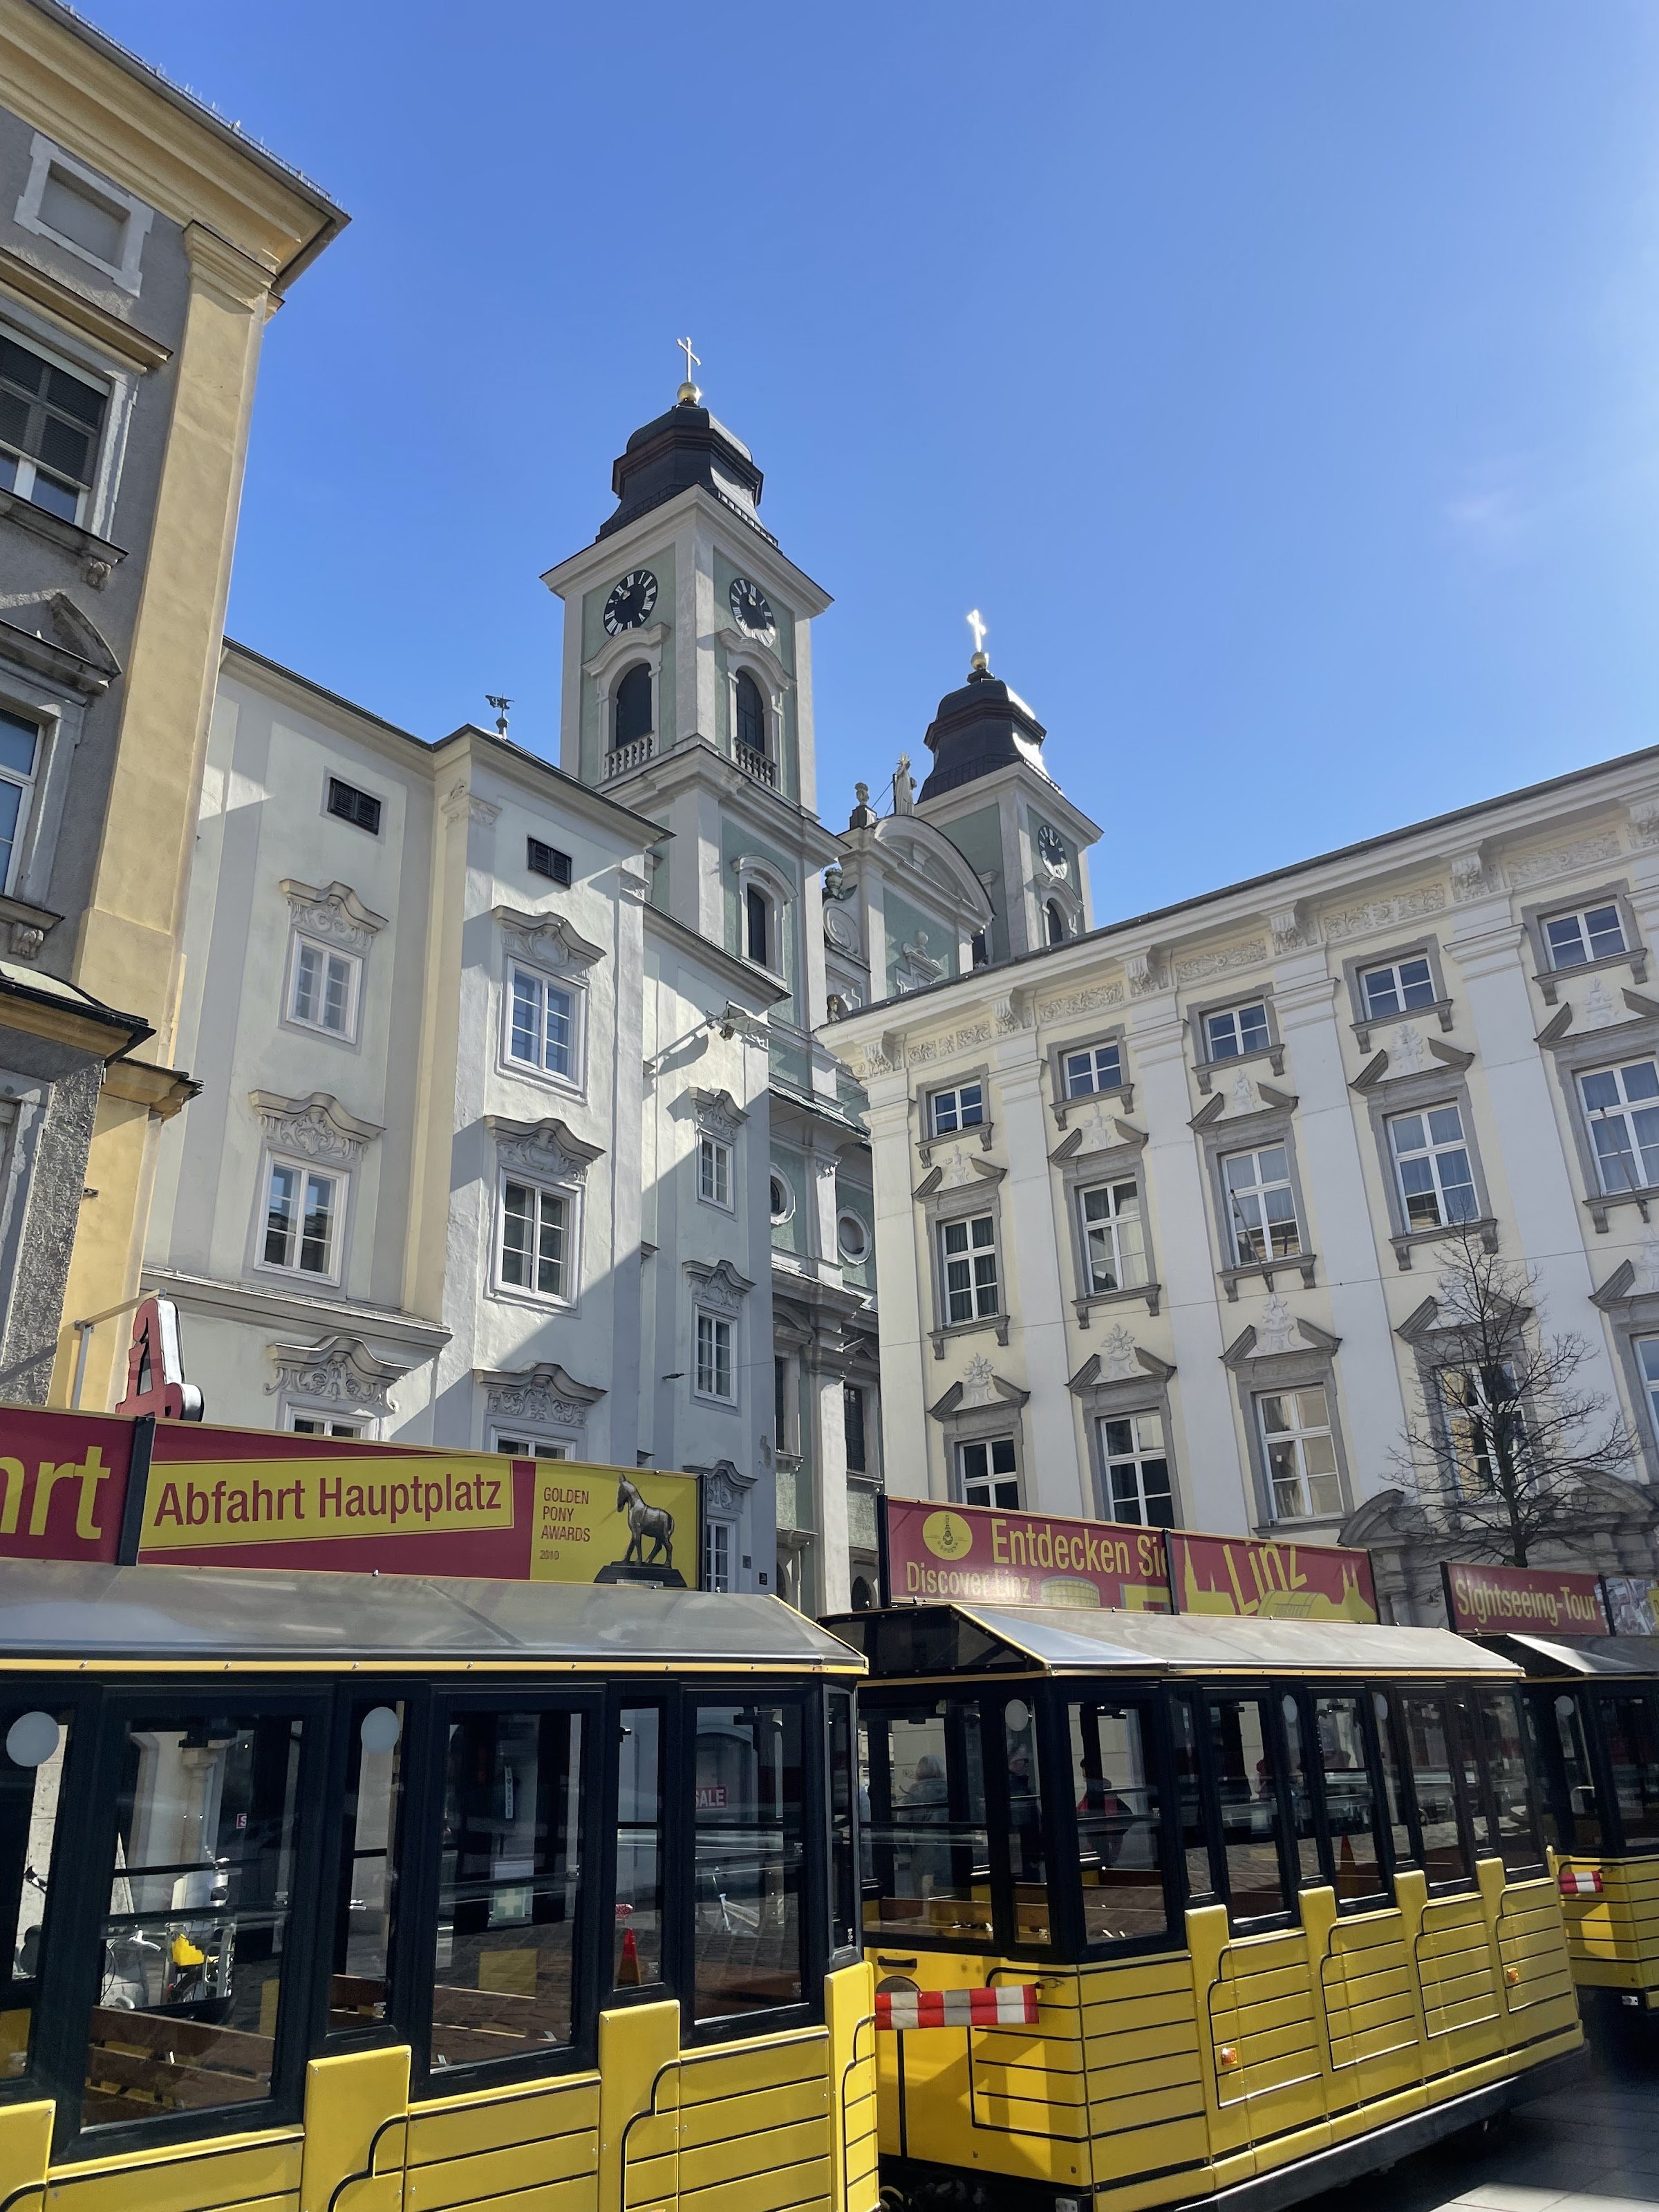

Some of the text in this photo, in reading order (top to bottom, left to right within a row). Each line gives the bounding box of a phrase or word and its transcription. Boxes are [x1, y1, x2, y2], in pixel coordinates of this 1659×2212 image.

[155, 1473, 502, 1527] Abfahrt Hauptplatz
[543, 1487, 590, 1505] GOLDEN
[543, 1506, 574, 1521] PONY
[541, 1525, 590, 1542] AWARDS
[991, 1518, 1130, 1574] Entdecken
[539, 1549, 560, 1560] 2010
[906, 1562, 1031, 1599] Discover Linz
[1222, 1541, 1308, 1615] Linz
[1454, 1577, 1597, 1627] Sightseeing-Tour
